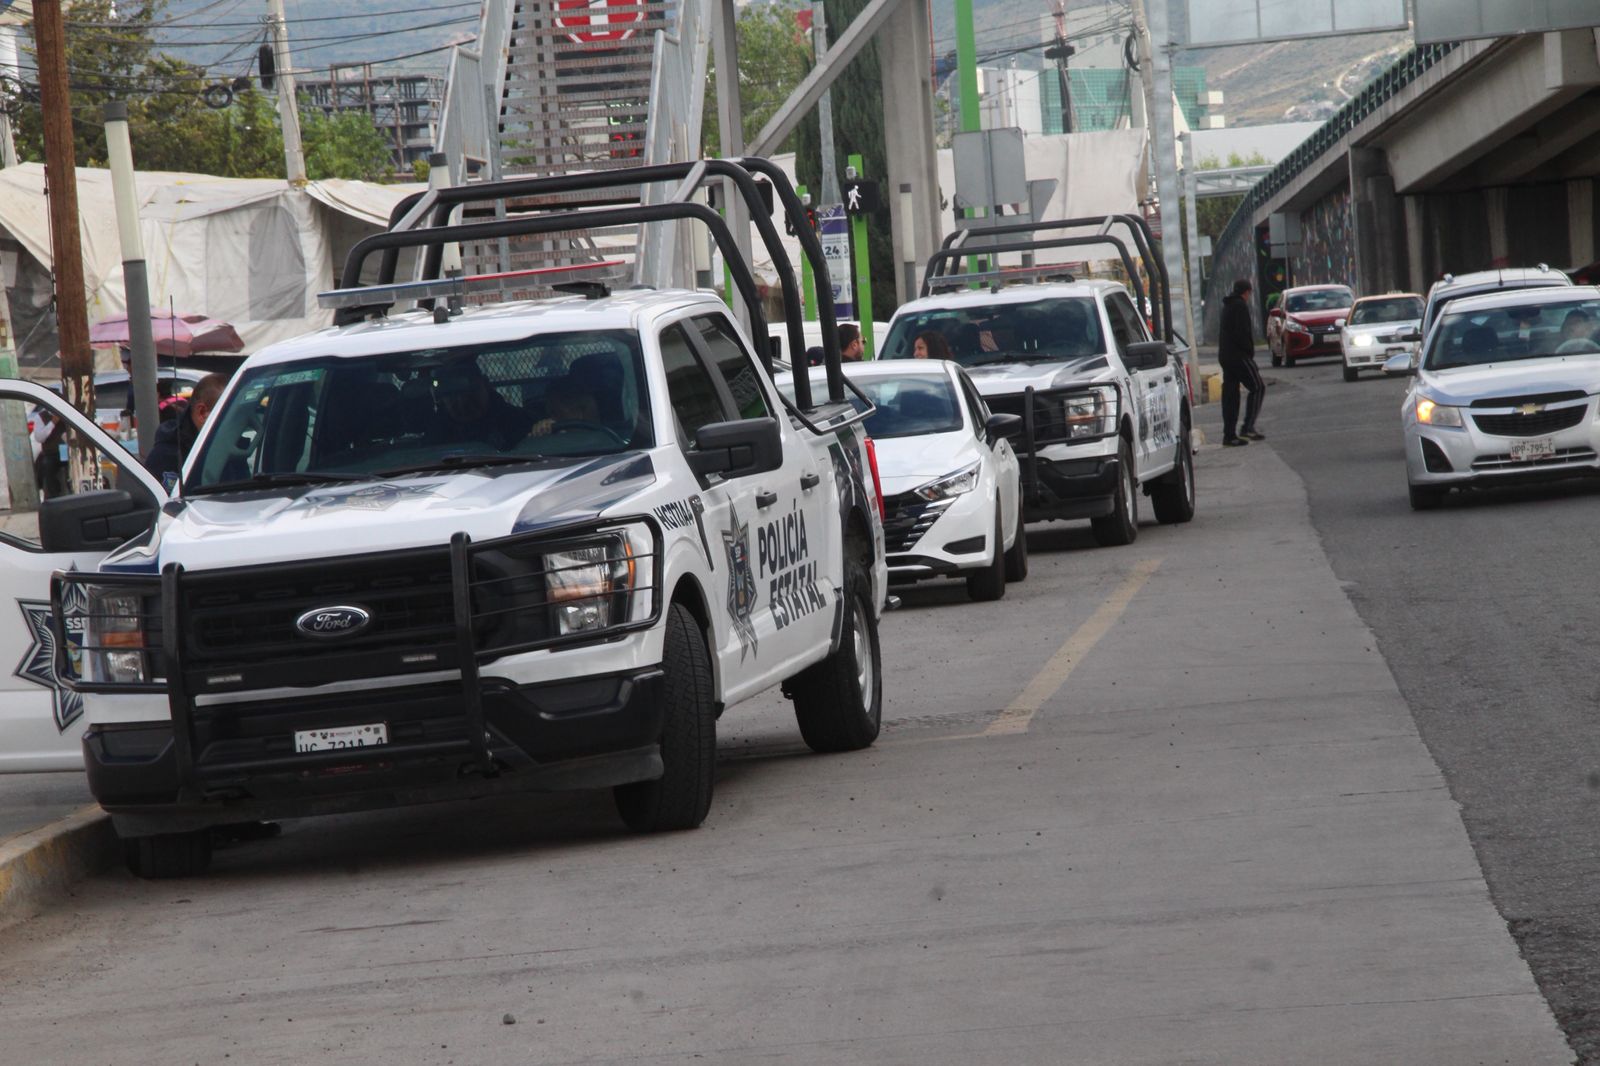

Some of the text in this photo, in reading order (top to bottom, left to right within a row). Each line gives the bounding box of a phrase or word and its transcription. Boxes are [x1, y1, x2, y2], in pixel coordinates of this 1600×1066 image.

[825, 246, 840, 256] 24
[758, 498, 808, 579] POLICÍA
[769, 560, 827, 631] ESTATAL
[314, 612, 351, 631] Ford
